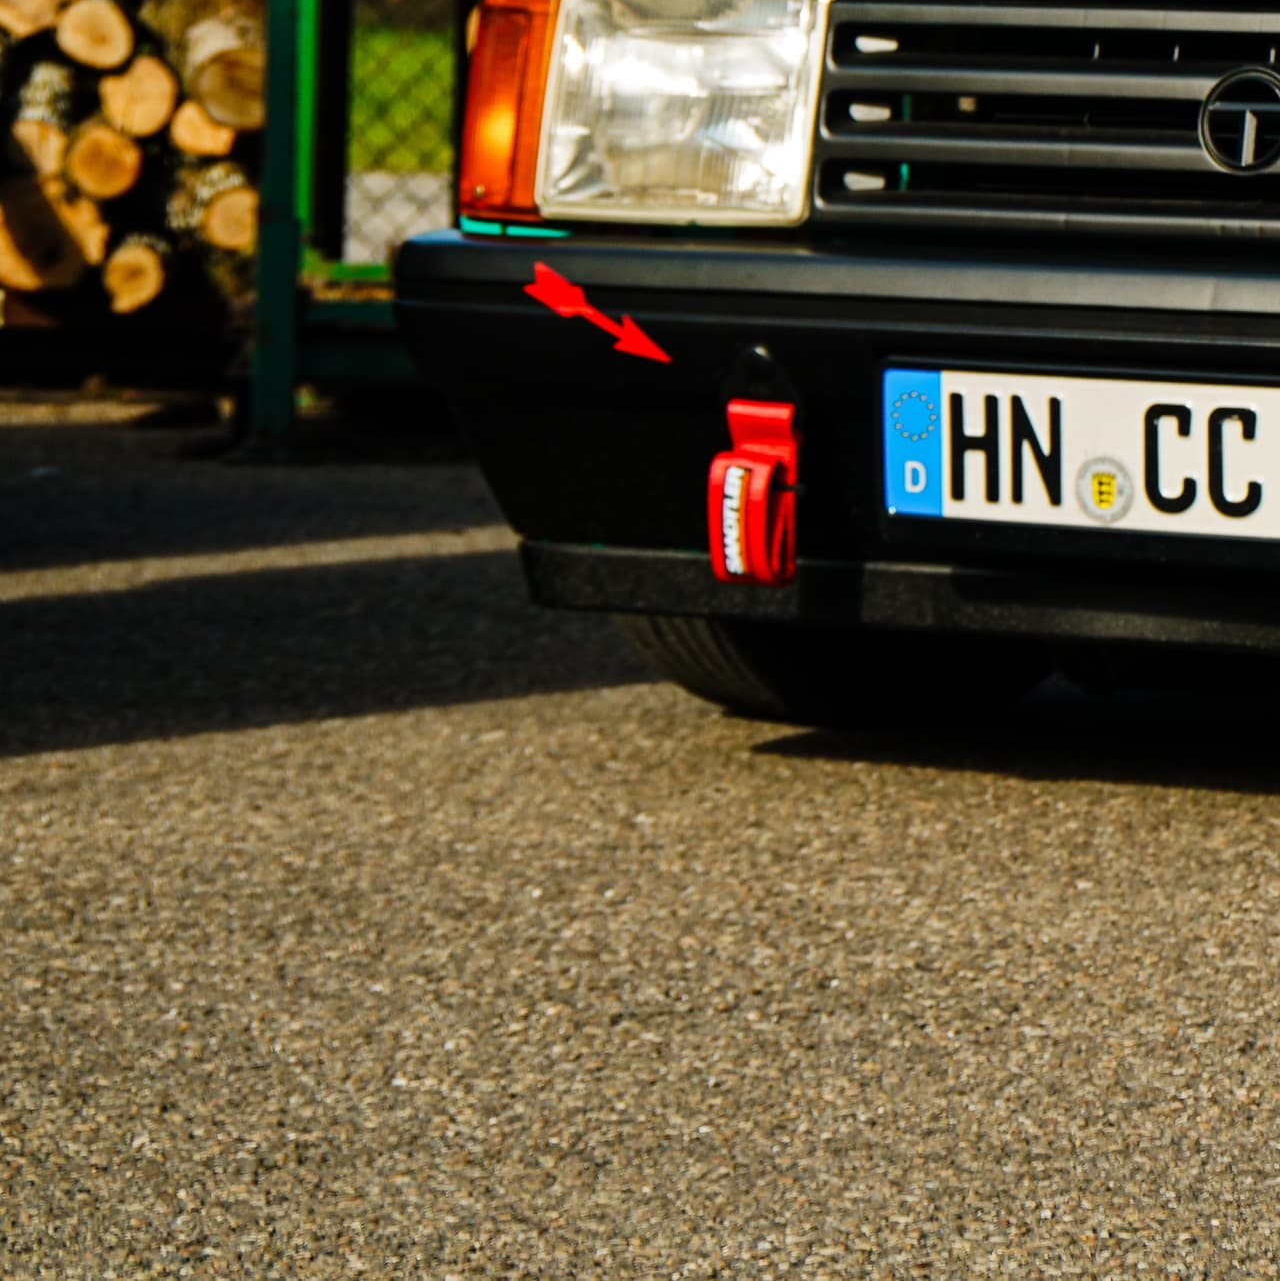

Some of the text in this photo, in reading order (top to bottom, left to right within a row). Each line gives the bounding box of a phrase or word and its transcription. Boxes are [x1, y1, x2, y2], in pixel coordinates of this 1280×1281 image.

[904, 460, 927, 493] D
[949, 392, 1062, 507] HN
[1144, 403, 1262, 518] CC
